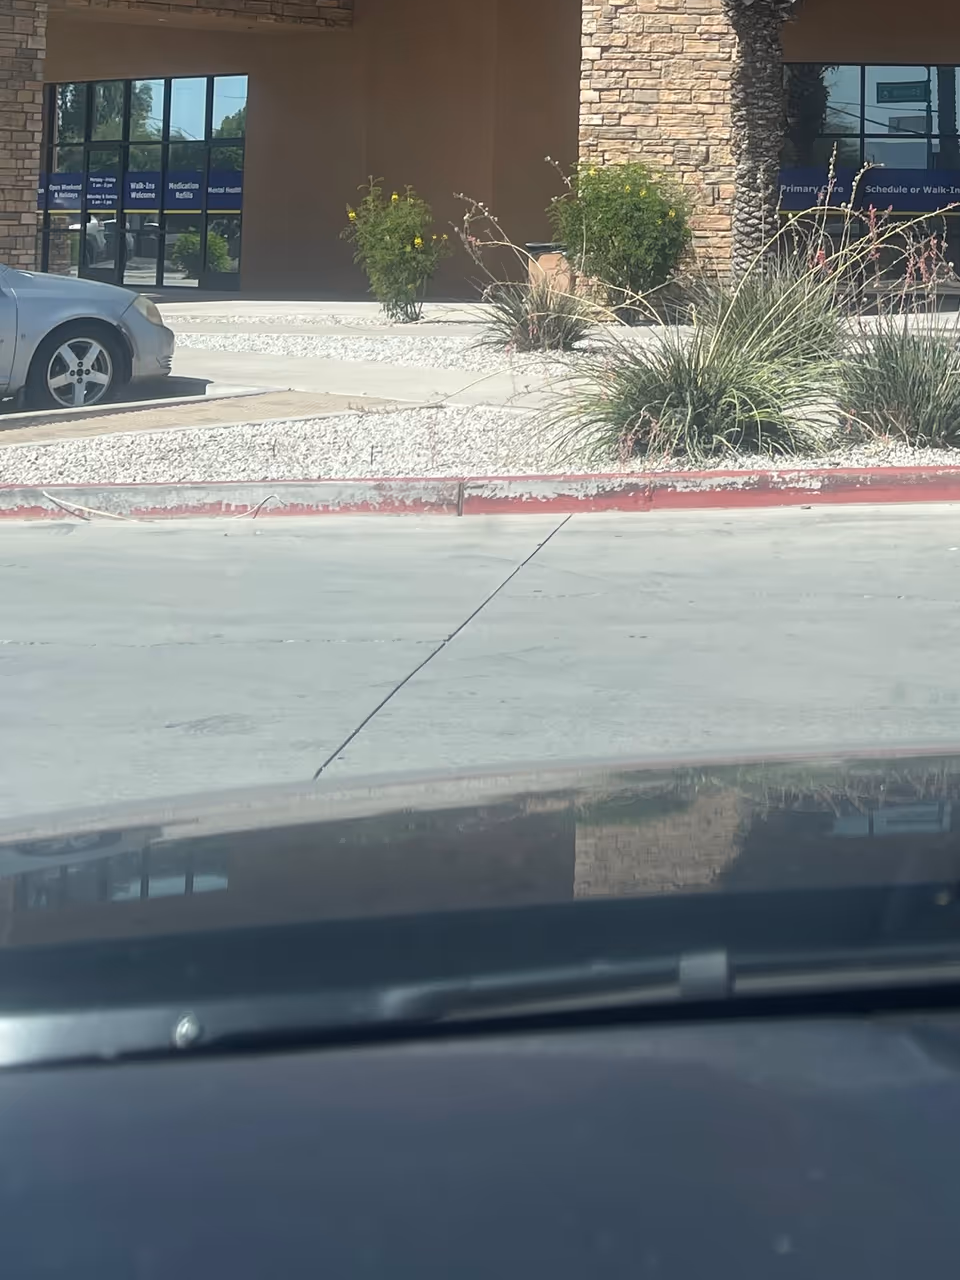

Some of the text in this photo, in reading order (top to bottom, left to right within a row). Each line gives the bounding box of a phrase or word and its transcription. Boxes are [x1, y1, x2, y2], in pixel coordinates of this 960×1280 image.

[61, 183, 82, 191] Weekend
[130, 182, 155, 190] Walk-Ins
[168, 182, 199, 190] Medication
[780, 185, 844, 195] Primary Cre
[865, 185, 908, 194] Schedule
[922, 185, 960, 194] Walk-In
[130, 191, 156, 199] Welcome
[175, 191, 193, 199] Refills
